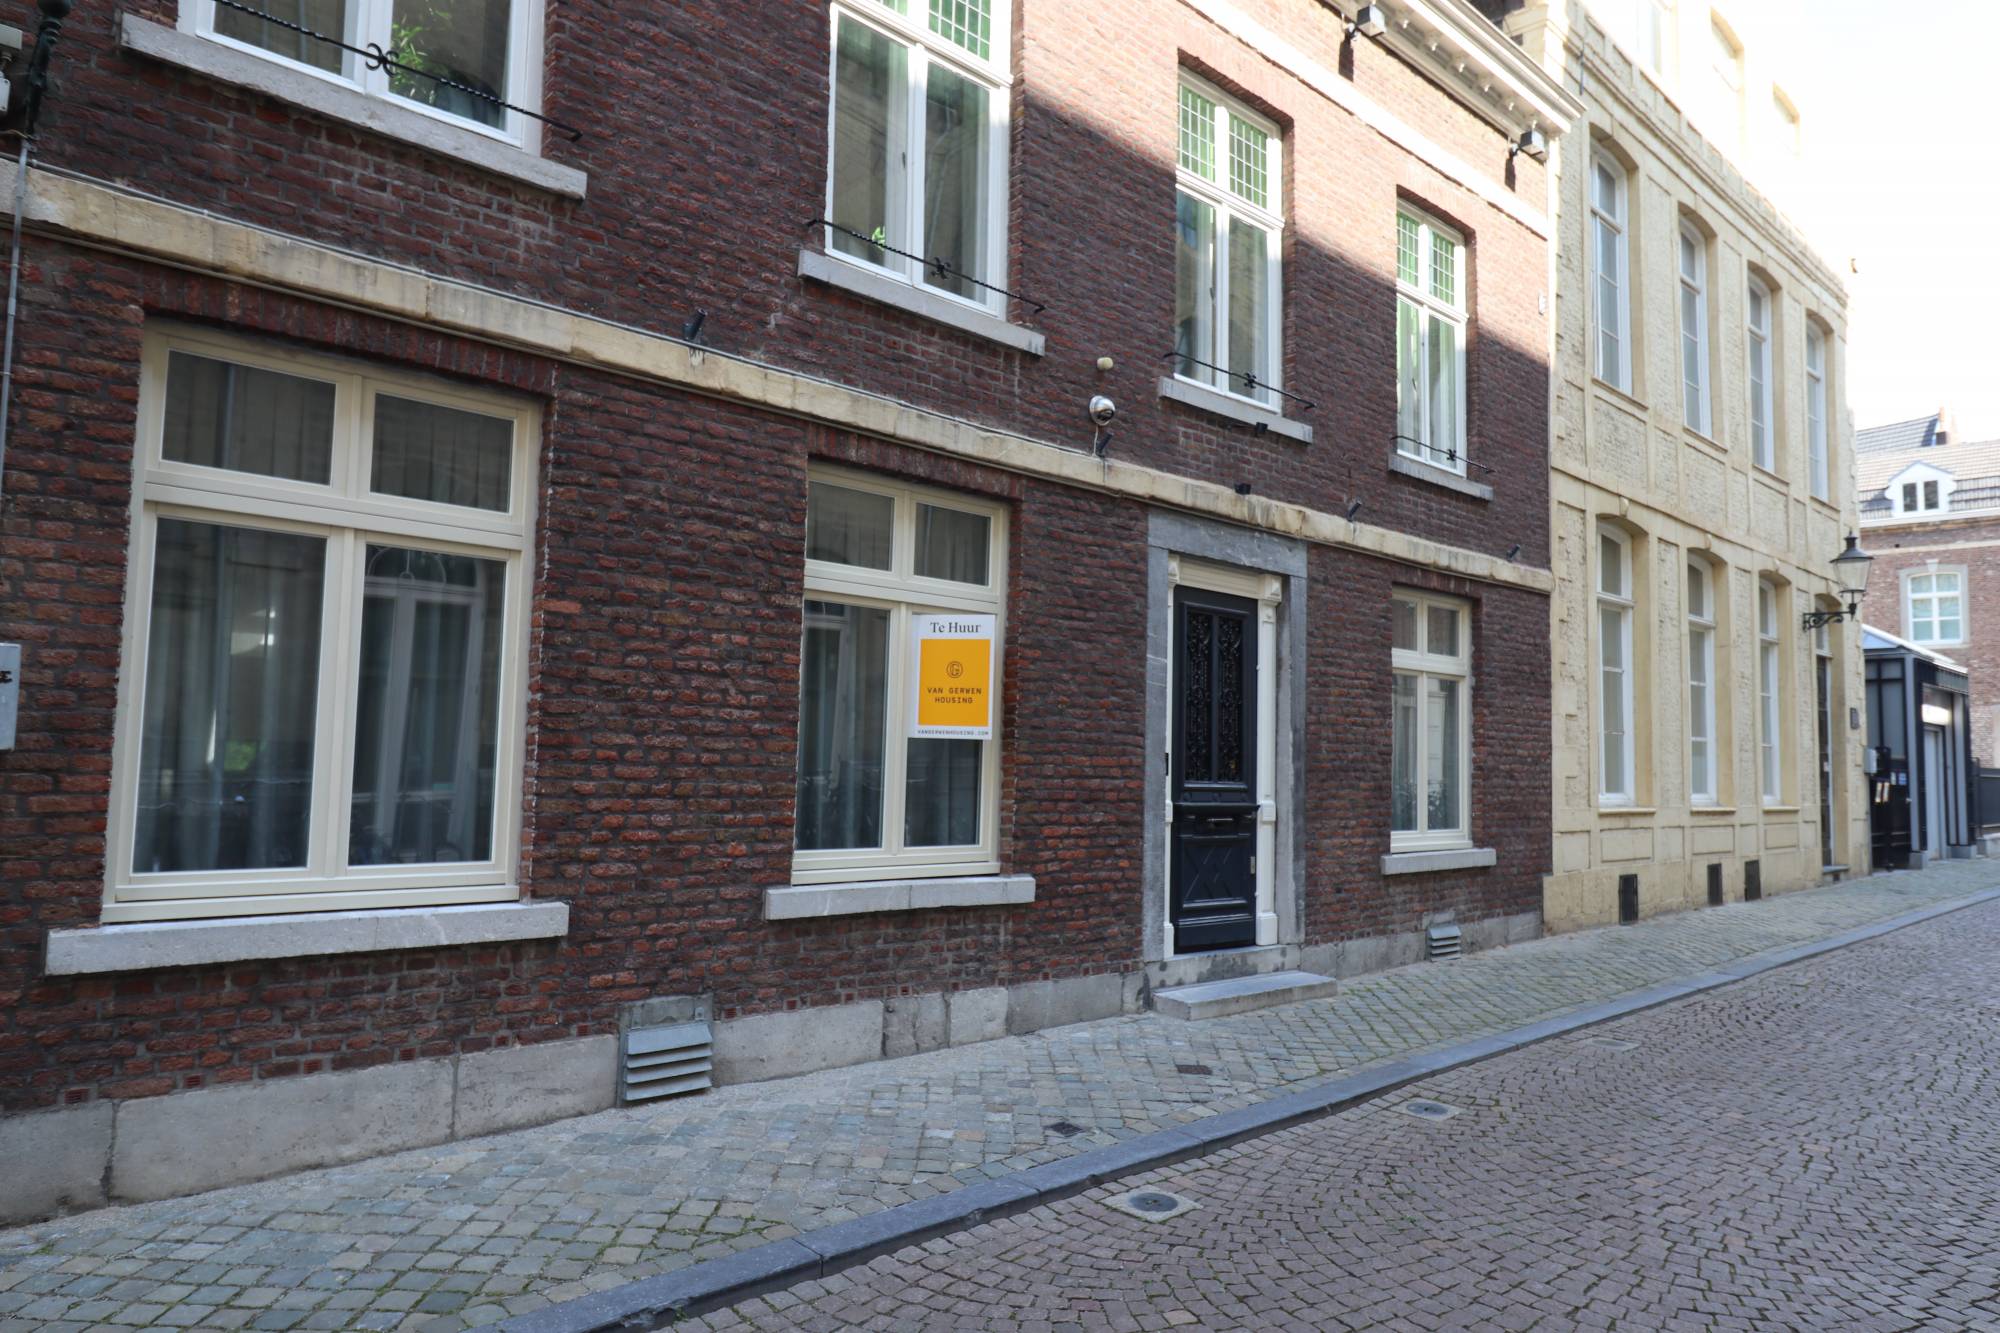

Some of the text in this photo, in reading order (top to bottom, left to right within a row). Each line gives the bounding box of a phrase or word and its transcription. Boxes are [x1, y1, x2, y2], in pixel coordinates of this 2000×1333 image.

[930, 622, 981, 633] Te Huur
[949, 687, 982, 695] GERWEN
[934, 696, 973, 704] HOUSING
